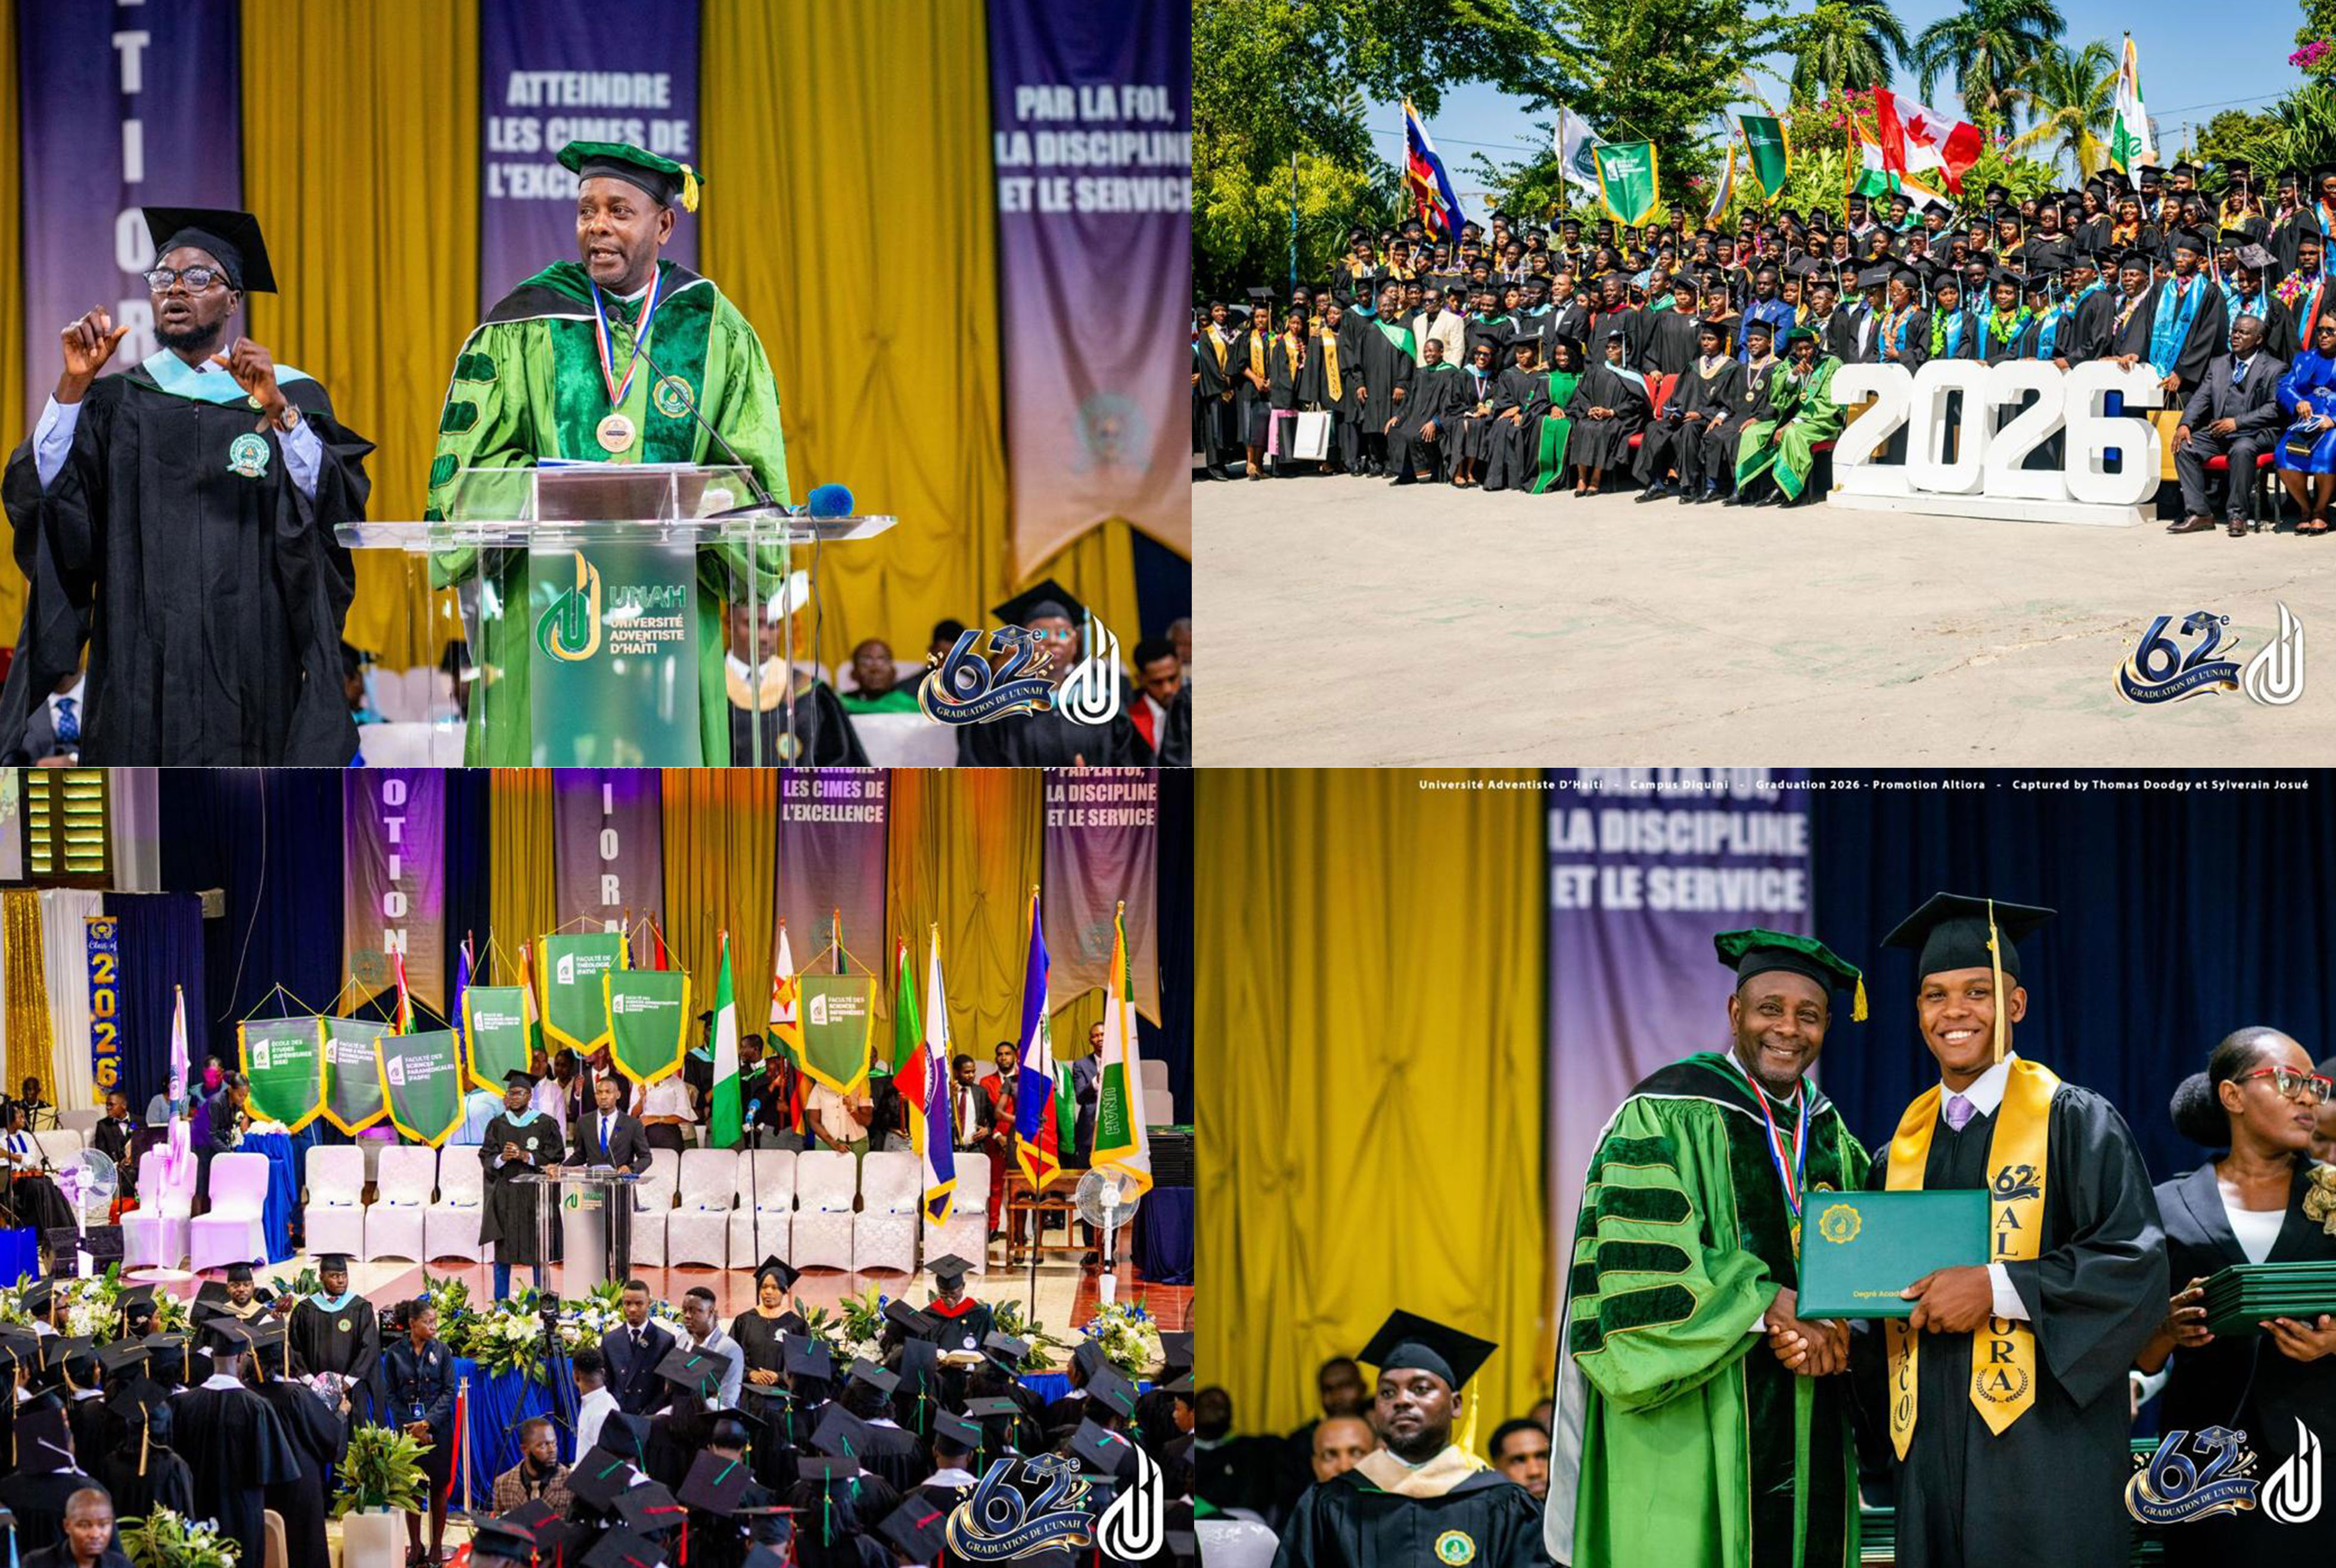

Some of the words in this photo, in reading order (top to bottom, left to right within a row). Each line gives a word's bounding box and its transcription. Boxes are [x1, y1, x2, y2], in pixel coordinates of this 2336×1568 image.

[507, 71, 671, 108] ATTEINDRE
[1016, 85, 1075, 121] PAR
[1079, 85, 1117, 121] LA
[1122, 85, 1176, 125] FOI,
[488, 116, 541, 152] LES
[546, 118, 646, 151] CIMES
[651, 120, 690, 155] DE
[995, 131, 1033, 167] LA
[999, 176, 1033, 212] ET
[1038, 176, 1071, 212] LE
[1831, 359, 2164, 504] 2026
[609, 585, 686, 608] UNAH
[610, 614, 684, 628] UNIVERSITÉ
[610, 630, 685, 641] ADVENTISTE
[783, 780, 809, 797] LES
[812, 780, 861, 798] CIMES
[865, 781, 885, 799] DE
[1046, 784, 1066, 802] LA
[1068, 783, 1157, 802] DISCIPLINE
[782, 803, 884, 822] L'EXCELLENCE
[1048, 809, 1066, 827] ET
[1068, 809, 1085, 827] LE
[1088, 808, 1155, 827] SERVICE
[1549, 808, 1596, 854] LA
[1600, 809, 1809, 856] DISCIPLINE
[1551, 864, 1597, 910] ET
[1601, 865, 1643, 911] LE
[1647, 866, 1807, 912] SERVICE
[92, 952, 118, 1088] 2026
[1102, 1087, 1120, 1135] UNAH
